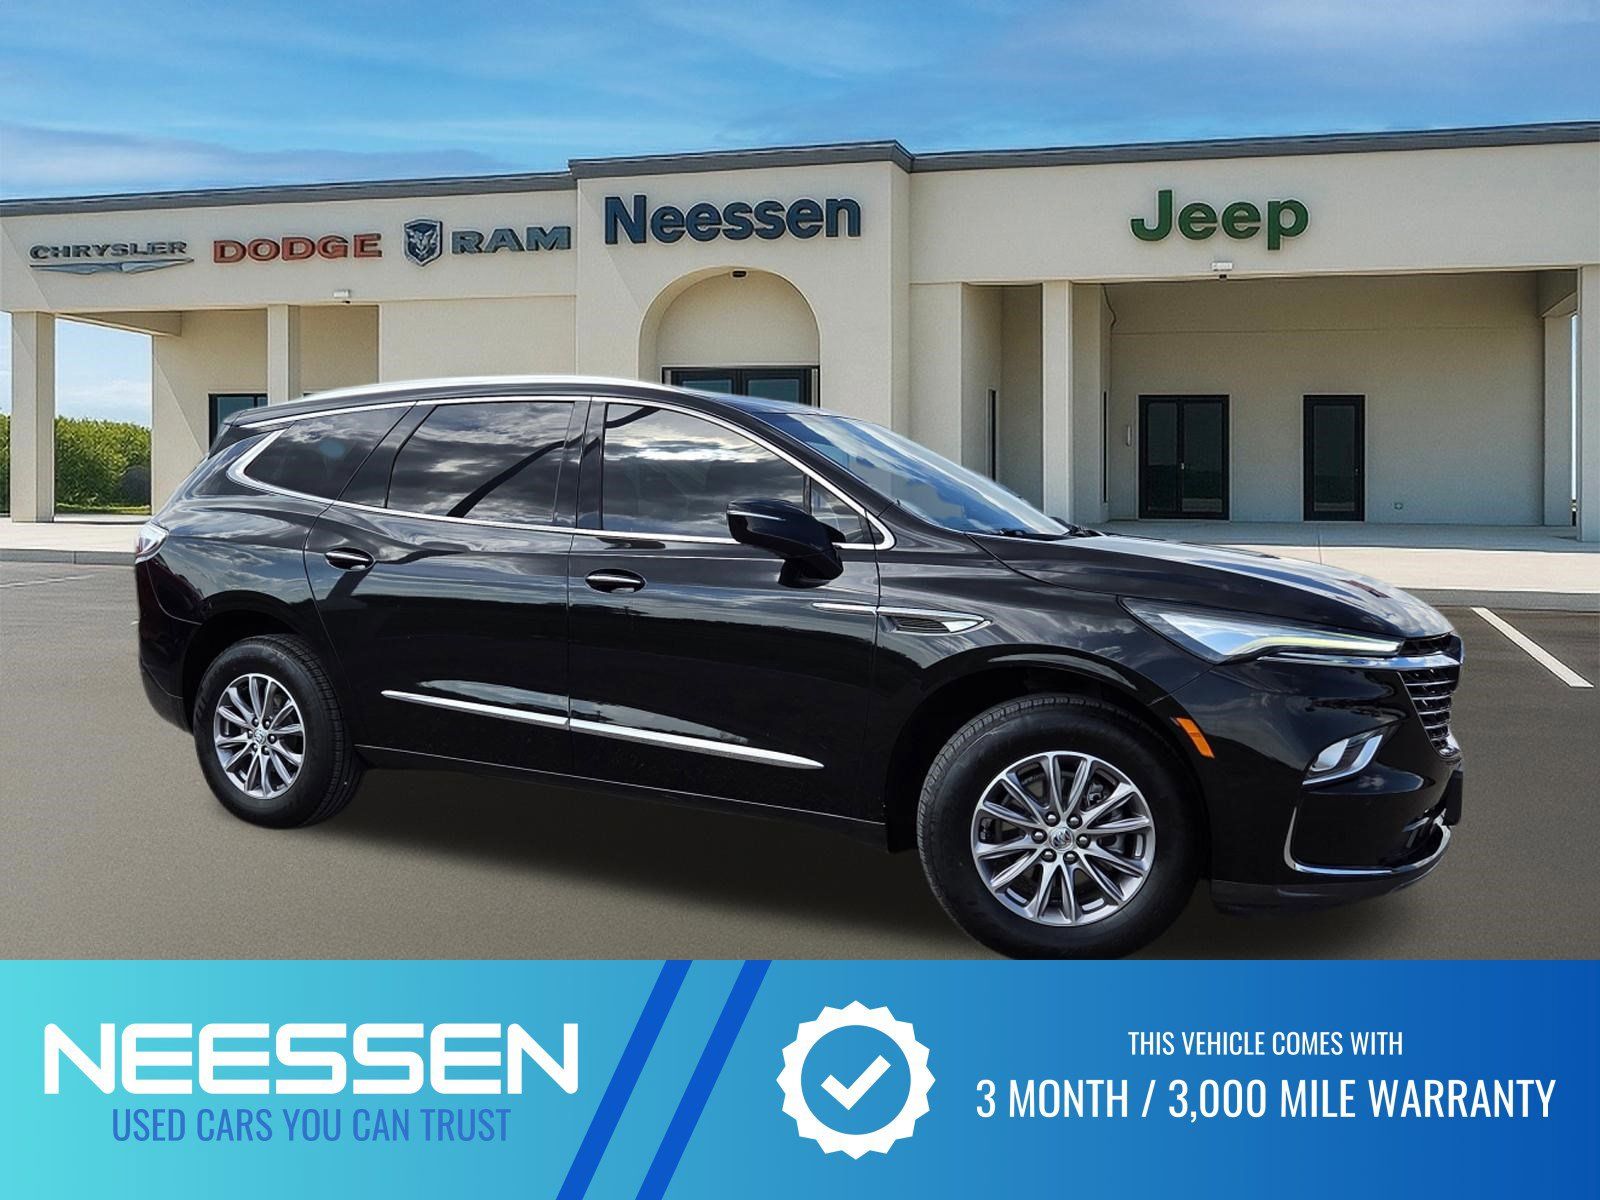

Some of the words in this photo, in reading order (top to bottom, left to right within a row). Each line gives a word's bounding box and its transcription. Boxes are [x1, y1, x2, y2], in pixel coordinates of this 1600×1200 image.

[604, 193, 862, 245] Neessen
[1130, 189, 1310, 251] Jeep
[29, 240, 188, 260] CHRYSLER
[213, 232, 383, 264] DODGE
[451, 225, 572, 255] RAM
